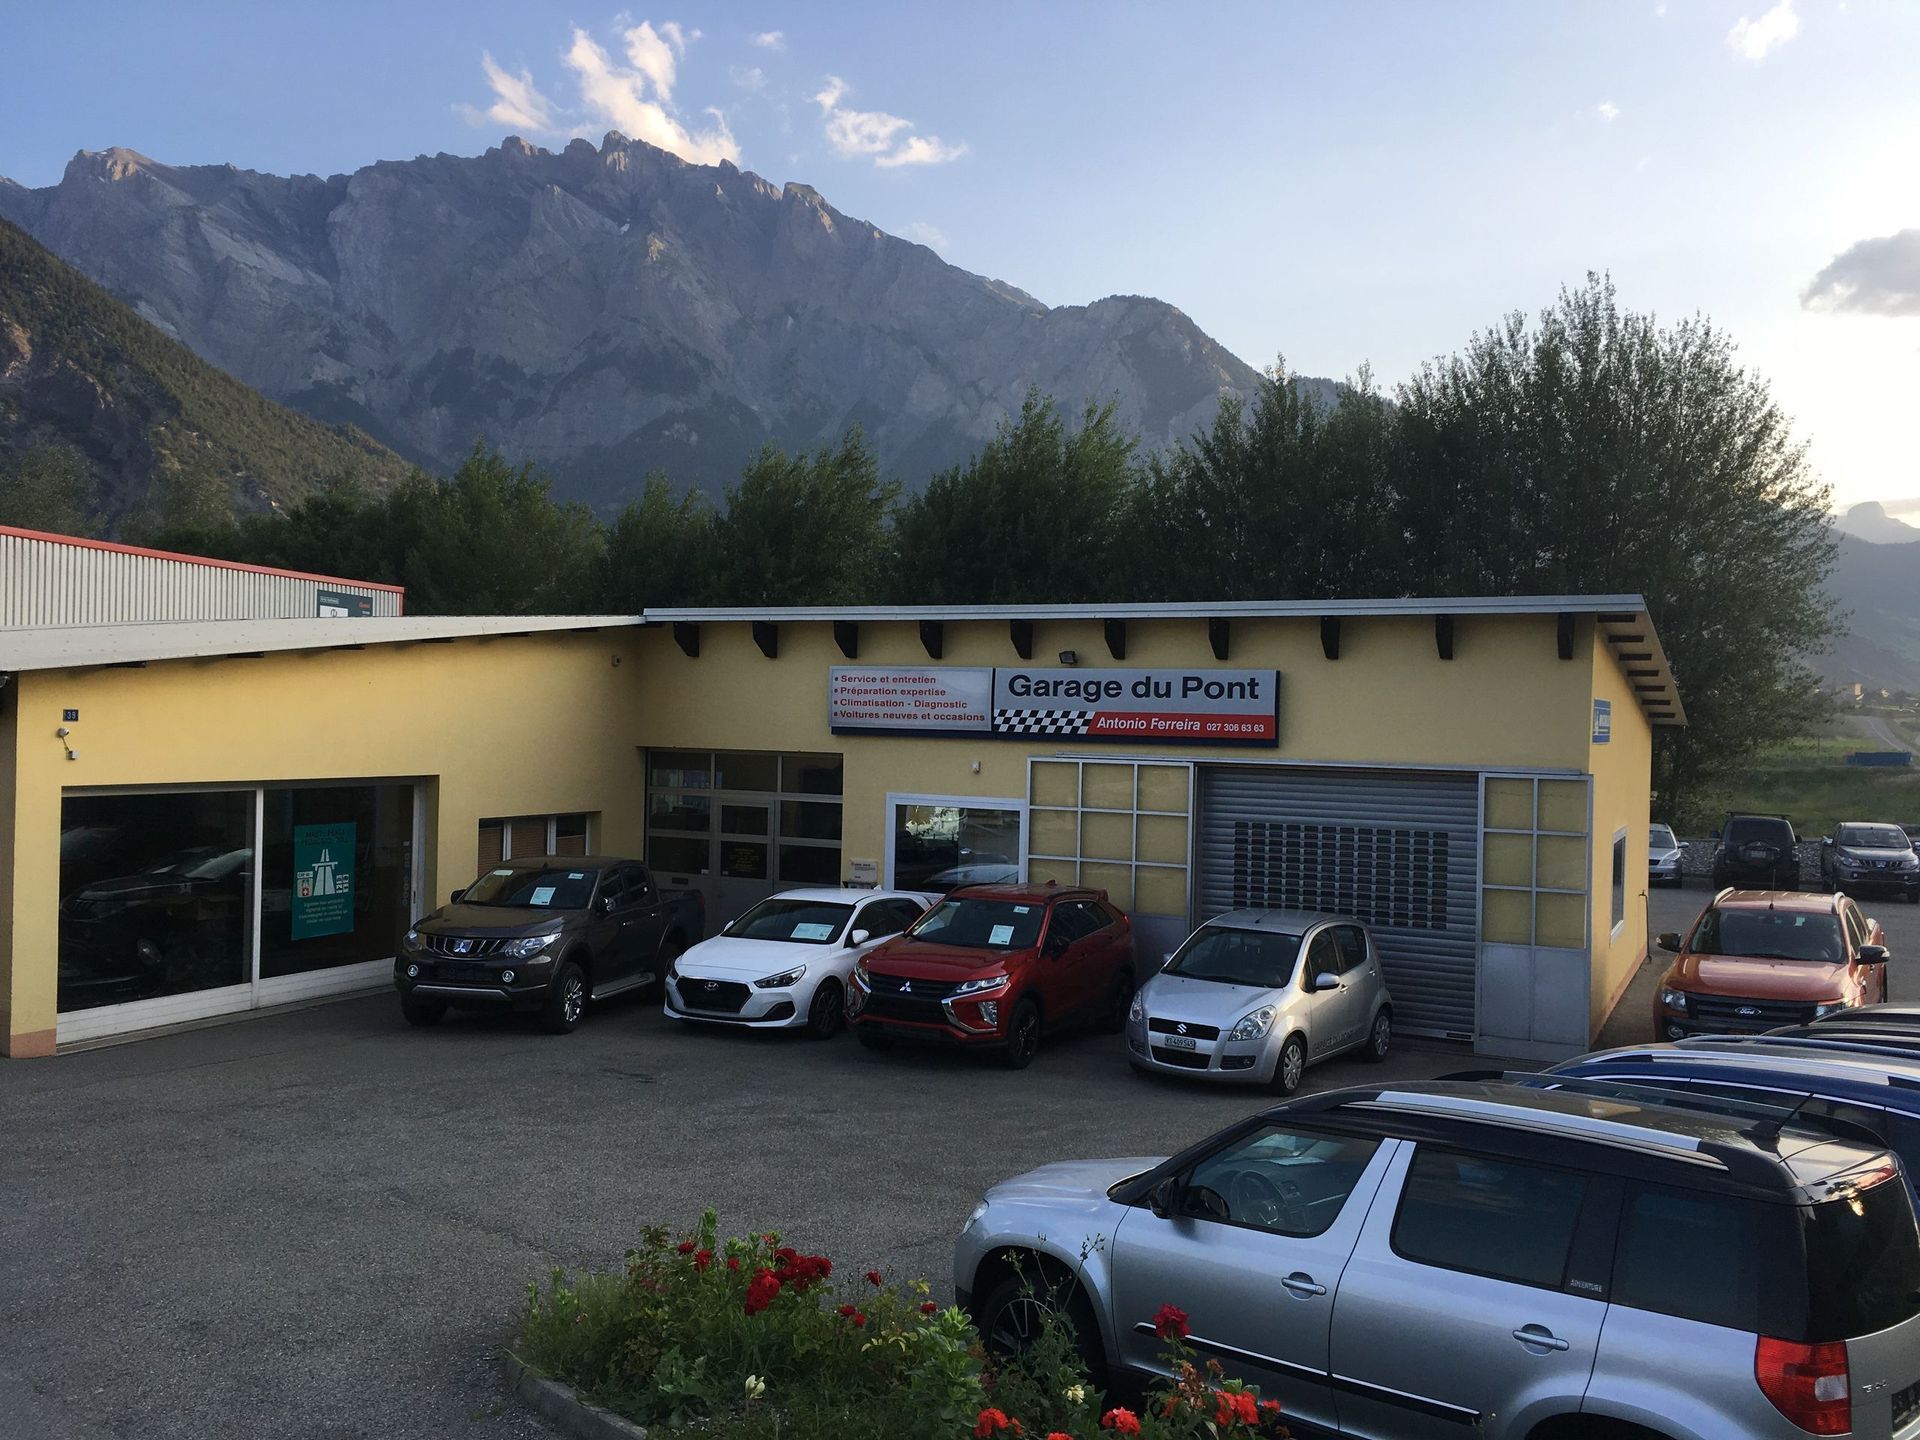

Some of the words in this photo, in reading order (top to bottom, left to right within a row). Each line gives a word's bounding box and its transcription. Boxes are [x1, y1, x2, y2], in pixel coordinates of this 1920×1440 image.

[841, 675, 876, 683] Service
[880, 675, 889, 683] et
[840, 687, 897, 696] Préparation
[900, 688, 946, 697] expertise
[1008, 674, 1123, 703] Garage
[1131, 676, 1172, 698] du
[1182, 676, 1259, 700] Pont
[840, 699, 904, 708] Climatisation
[914, 700, 968, 710] Diagnostic
[840, 710, 880, 719] Voitures
[921, 712, 930, 720] et
[934, 712, 985, 721] occasions
[1097, 717, 1147, 729] Antonio
[1150, 718, 1201, 731] Ferreira
[1206, 723, 1221, 731] 027
[1241, 724, 1252, 732] 63
[1254, 724, 1264, 733] 63
